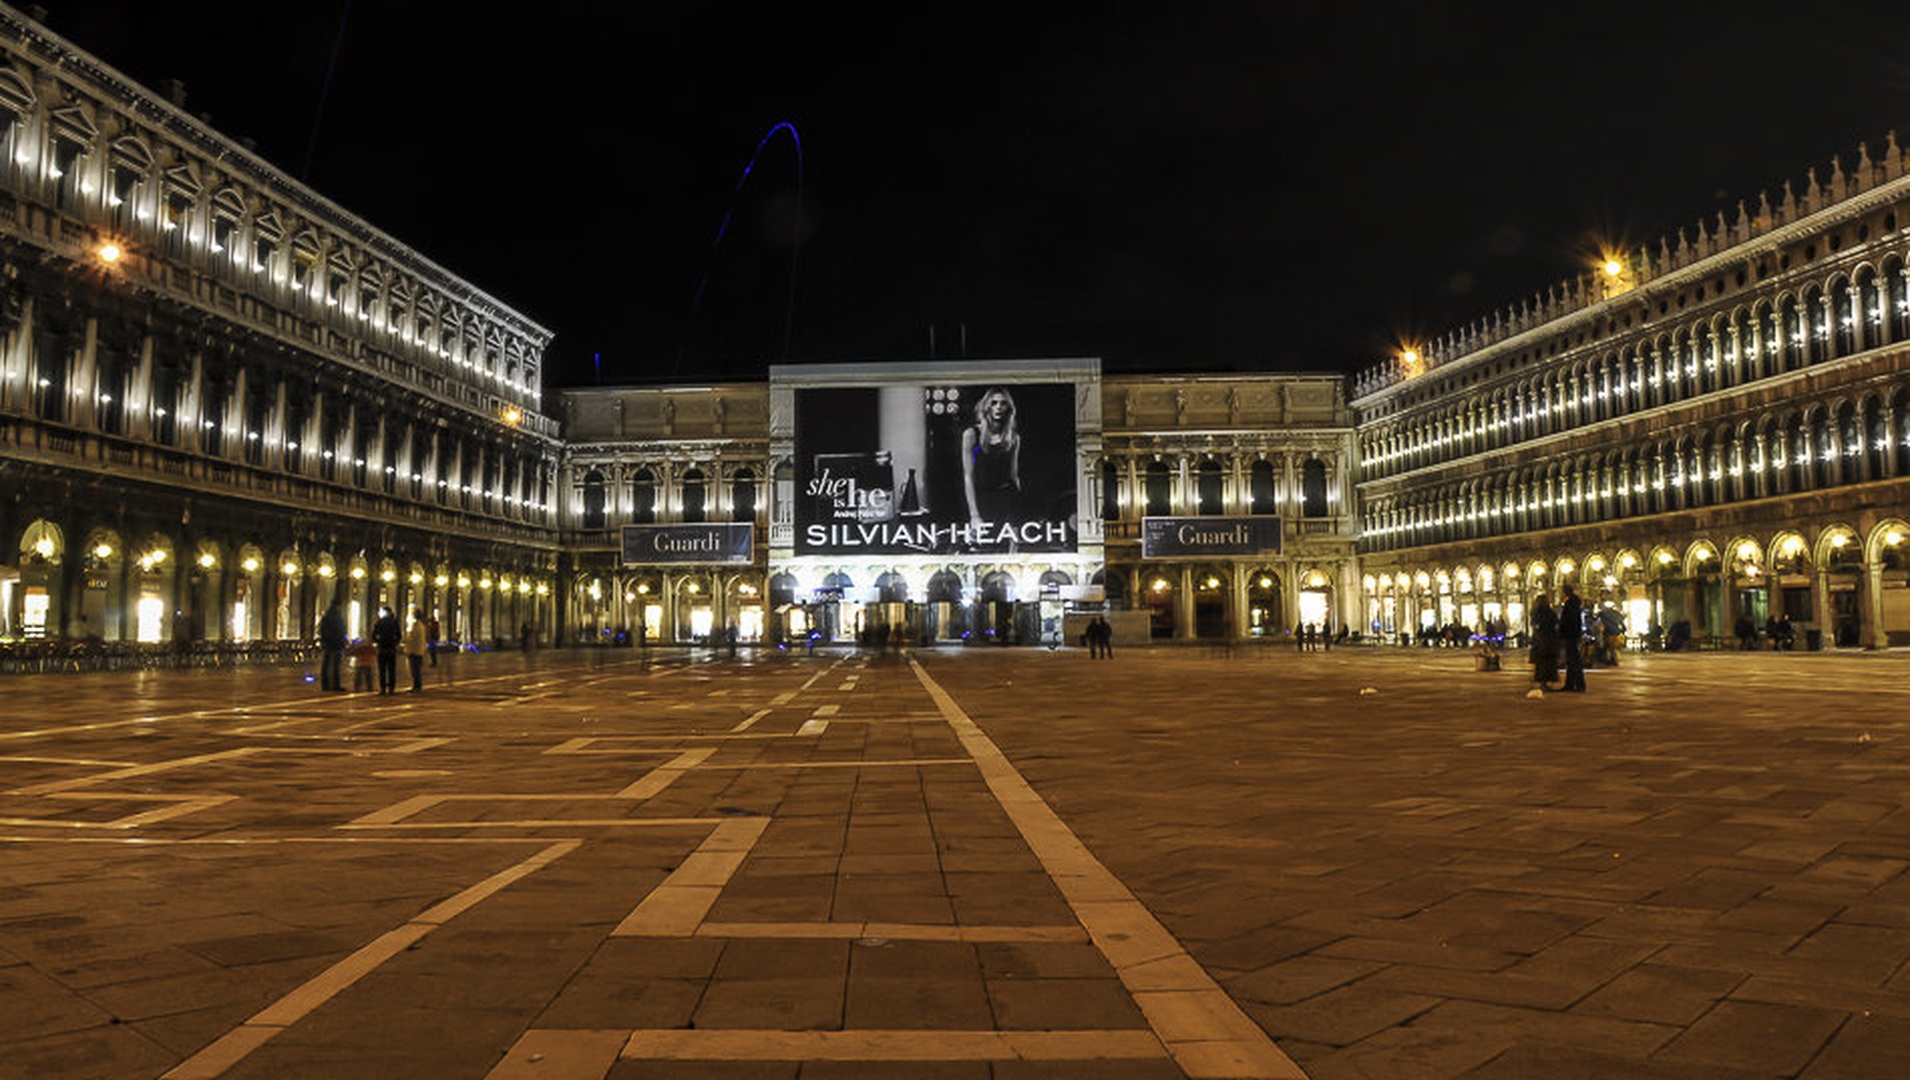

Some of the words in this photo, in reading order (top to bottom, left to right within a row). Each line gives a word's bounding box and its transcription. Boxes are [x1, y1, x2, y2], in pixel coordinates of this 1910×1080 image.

[806, 468, 847, 496] she
[847, 478, 886, 507] he
[653, 532, 720, 551] Guardi
[806, 523, 937, 545] SILVIAN
[950, 521, 1067, 543] HEACH
[1178, 524, 1249, 545] Guardi
